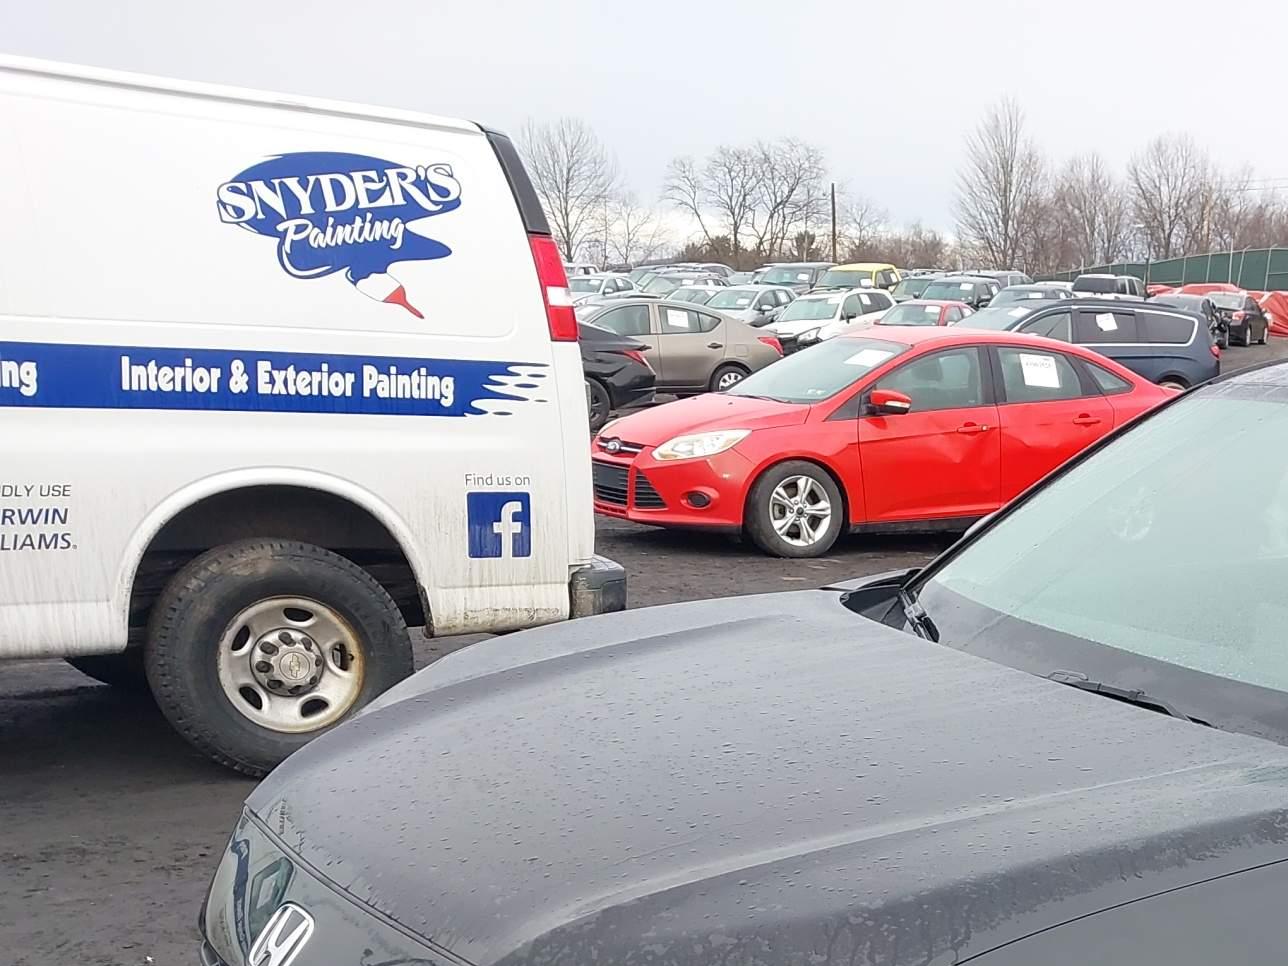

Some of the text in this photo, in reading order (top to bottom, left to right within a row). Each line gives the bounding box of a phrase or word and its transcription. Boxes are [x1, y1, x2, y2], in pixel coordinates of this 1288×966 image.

[217, 163, 462, 224] SNYDER'S
[277, 213, 405, 250] Painting
[121, 356, 455, 407] Interior & Exterior Painting
[0, 484, 72, 497] DLY USE
[465, 473, 531, 486] Find us on
[1, 508, 69, 525] RWIN
